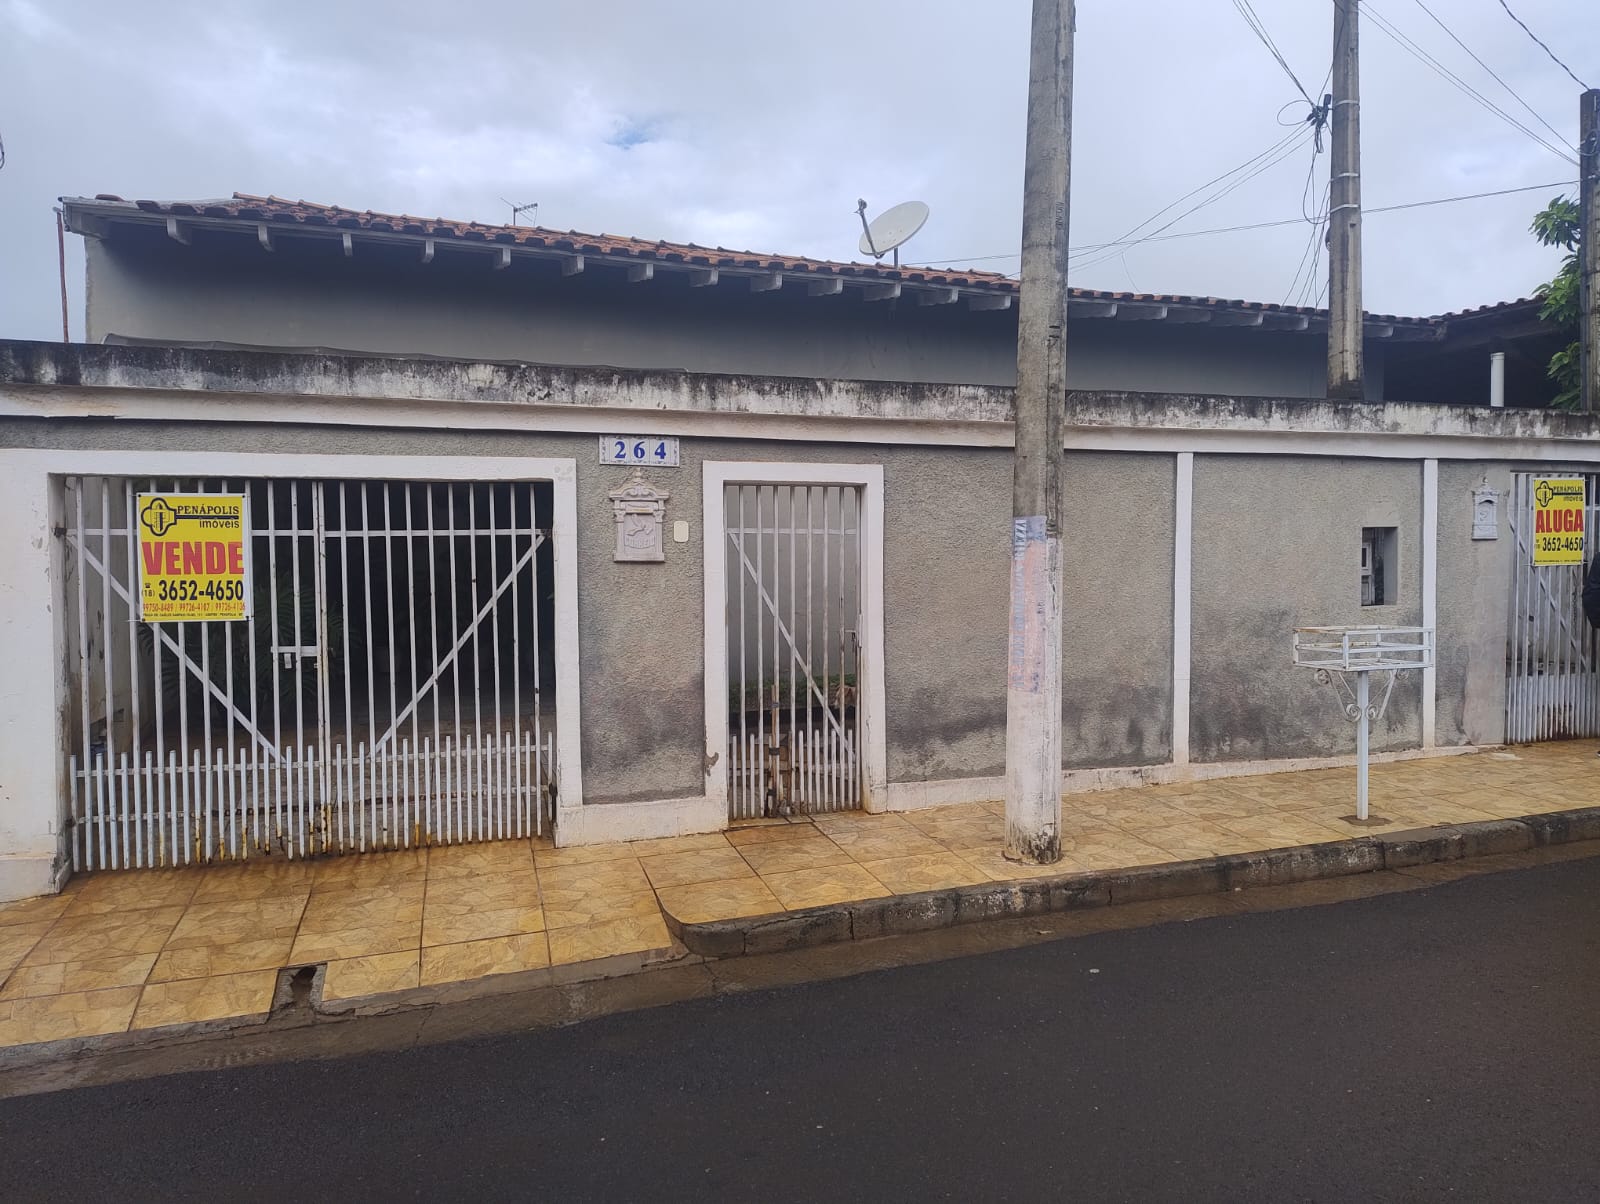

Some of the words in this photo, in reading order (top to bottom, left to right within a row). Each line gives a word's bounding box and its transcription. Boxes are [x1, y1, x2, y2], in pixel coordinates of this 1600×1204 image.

[614, 441, 666, 459] 264
[177, 504, 239, 514] PENÁPOLIS
[200, 518, 240, 528] imóveis
[1536, 509, 1584, 533] ALUGA
[1542, 537, 1584, 552] 3652-4650
[142, 541, 244, 575] VENDE
[159, 580, 244, 601] 3652-4650
